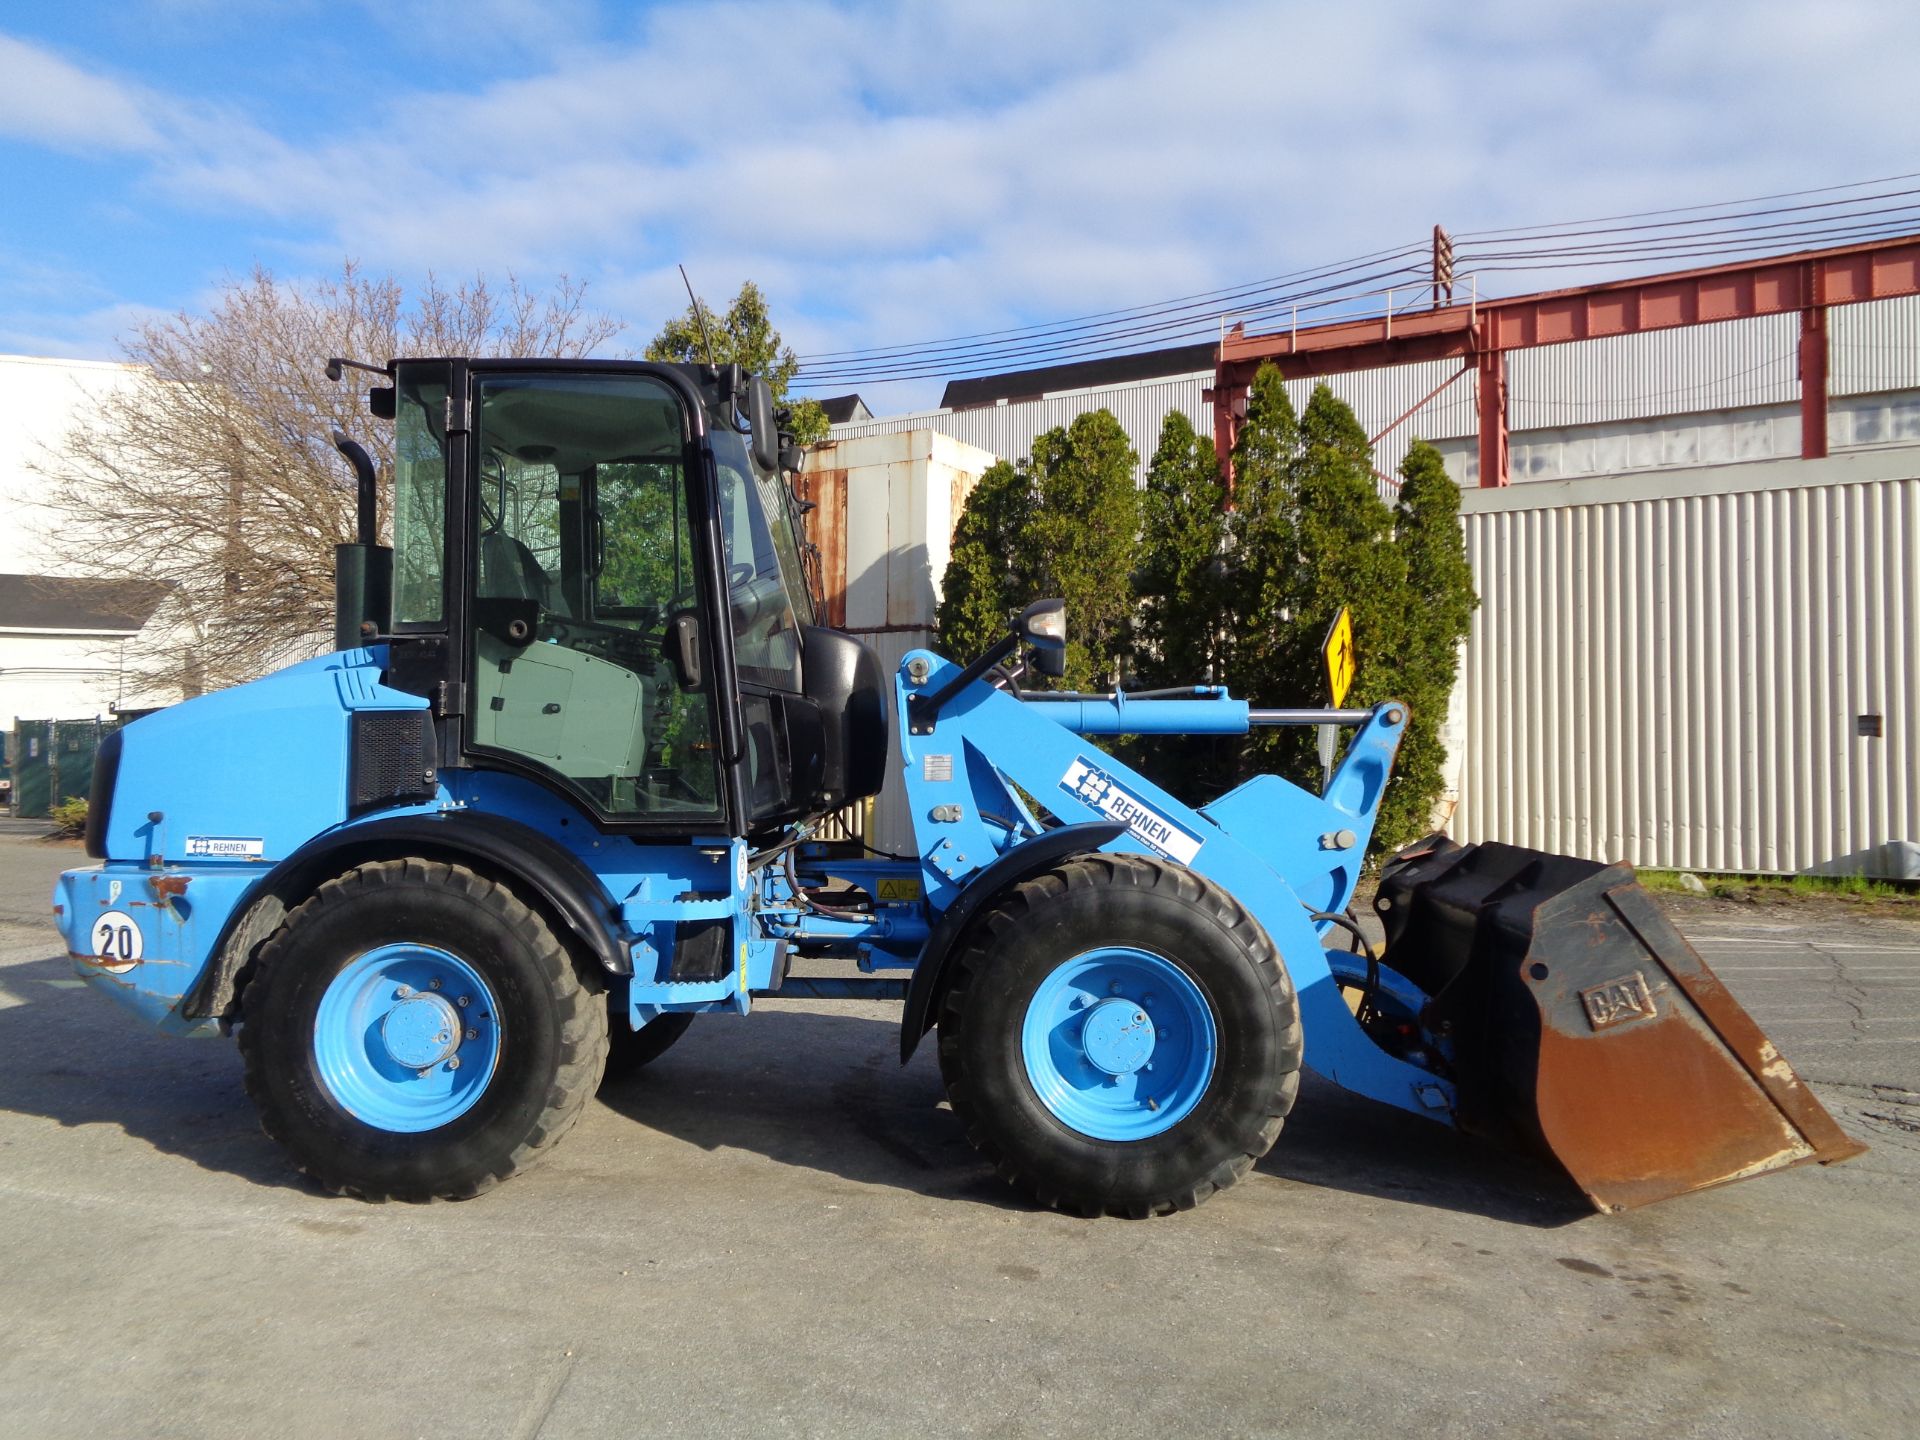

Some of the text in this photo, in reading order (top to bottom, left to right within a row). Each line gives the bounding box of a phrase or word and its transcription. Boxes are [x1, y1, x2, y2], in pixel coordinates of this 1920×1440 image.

[1110, 796, 1172, 844] REHNEN
[213, 843, 247, 852] REHNEN
[100, 924, 132, 959] 20
[1587, 978, 1643, 1023] CAT
